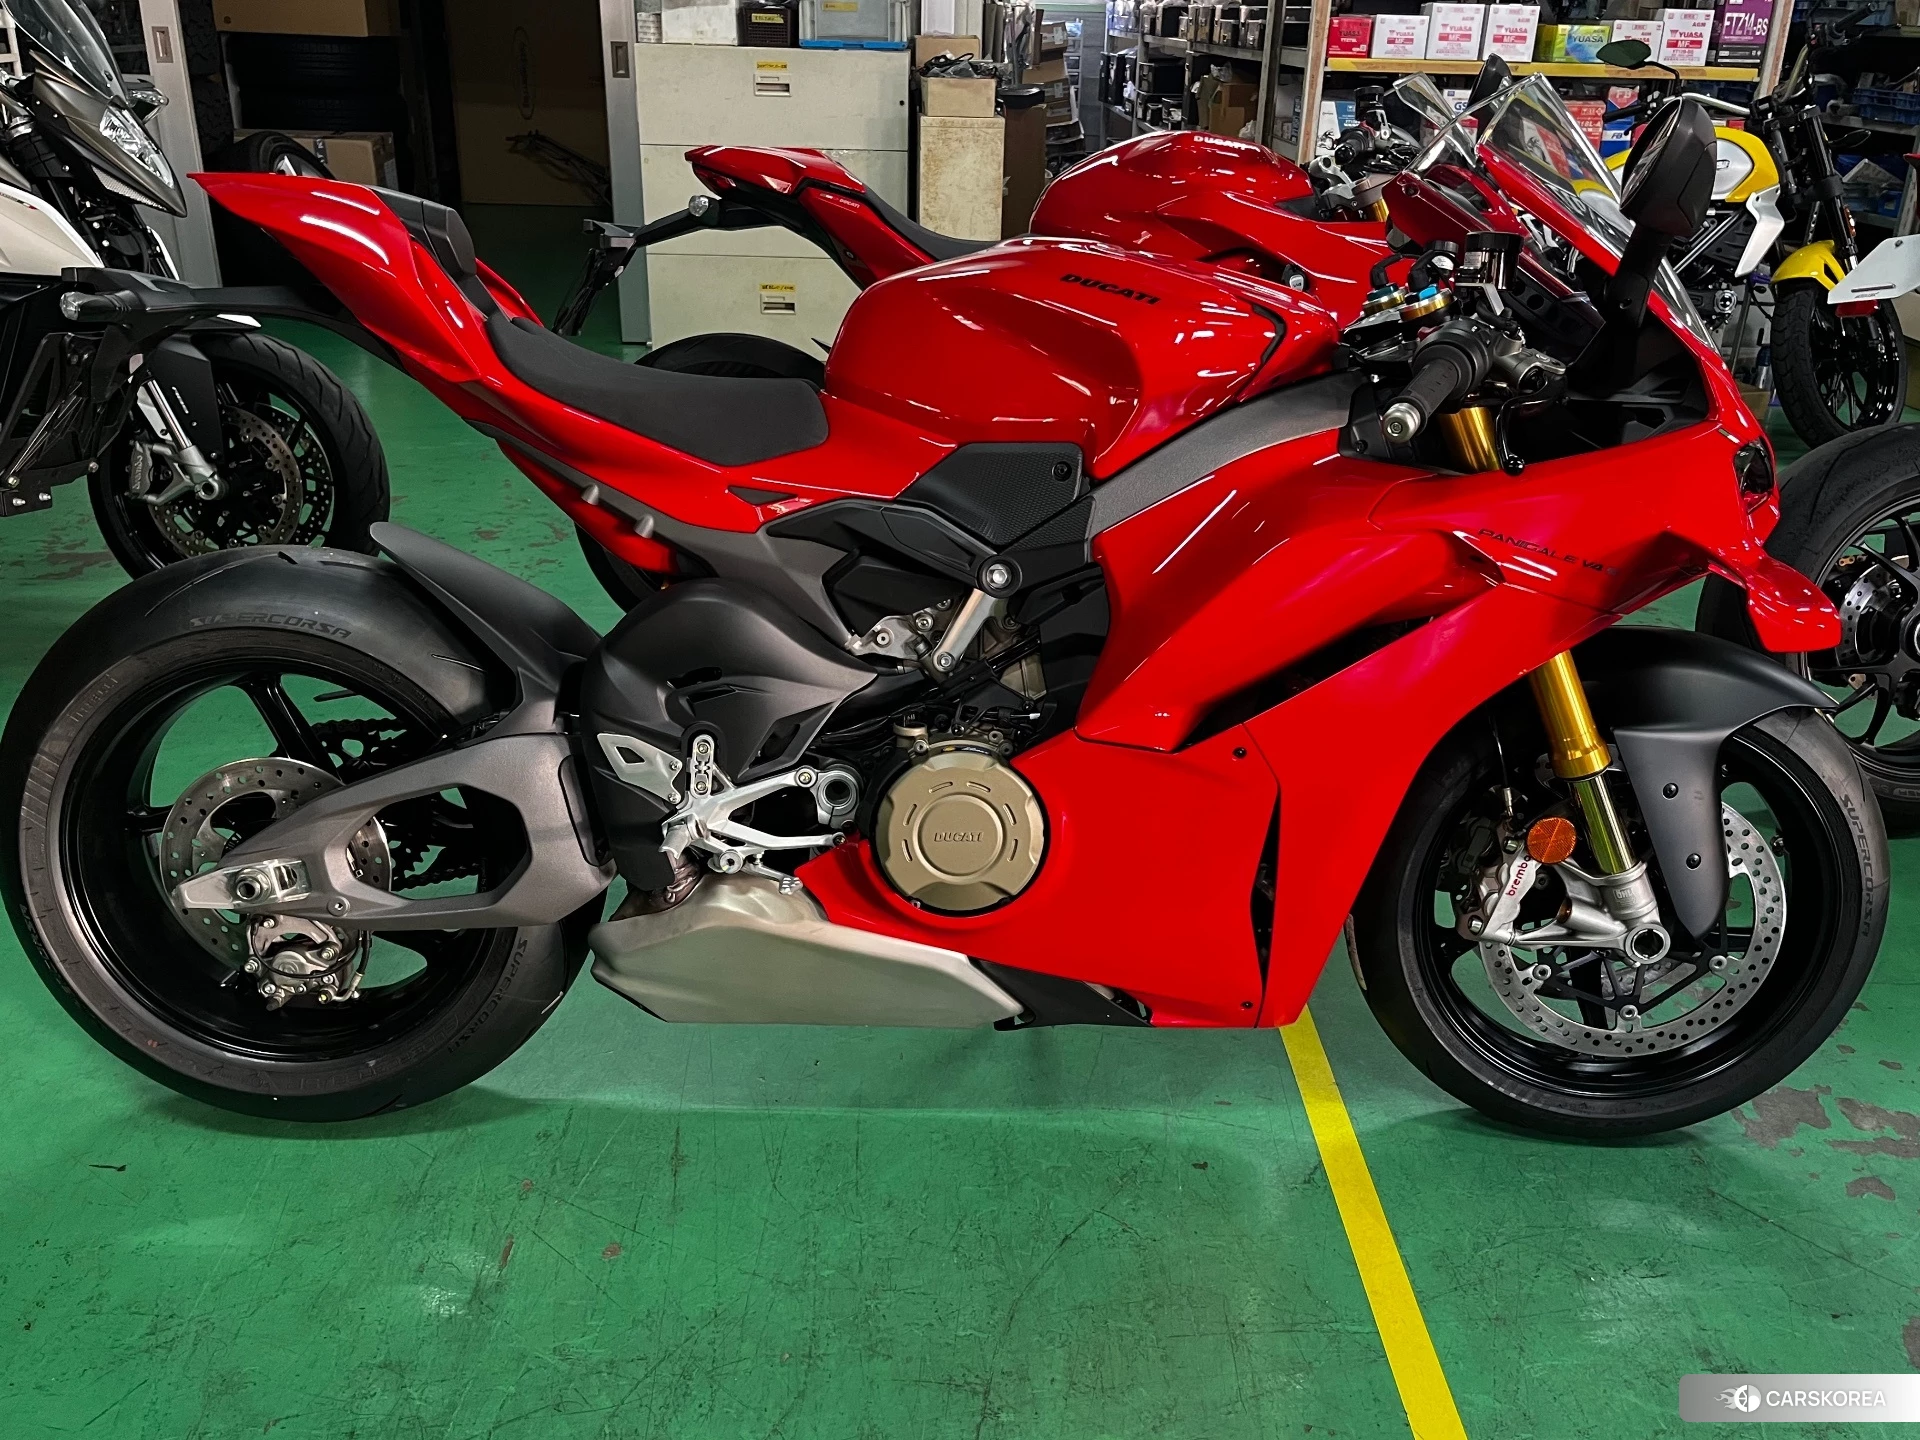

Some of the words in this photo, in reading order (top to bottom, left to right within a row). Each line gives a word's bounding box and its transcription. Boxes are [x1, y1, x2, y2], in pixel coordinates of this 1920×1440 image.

[1573, 35, 1604, 43] YUASA
[1677, 40, 1690, 48] MF
[1060, 273, 1161, 305] DUCATI
[1478, 528, 1579, 564] PANIGALE
[1582, 559, 1604, 572] V4
[189, 611, 352, 640] SUPERCORSA
[933, 831, 984, 843] DUCATI
[1505, 854, 1532, 897] brembo
[1838, 793, 1874, 938] SUPERCORSA
